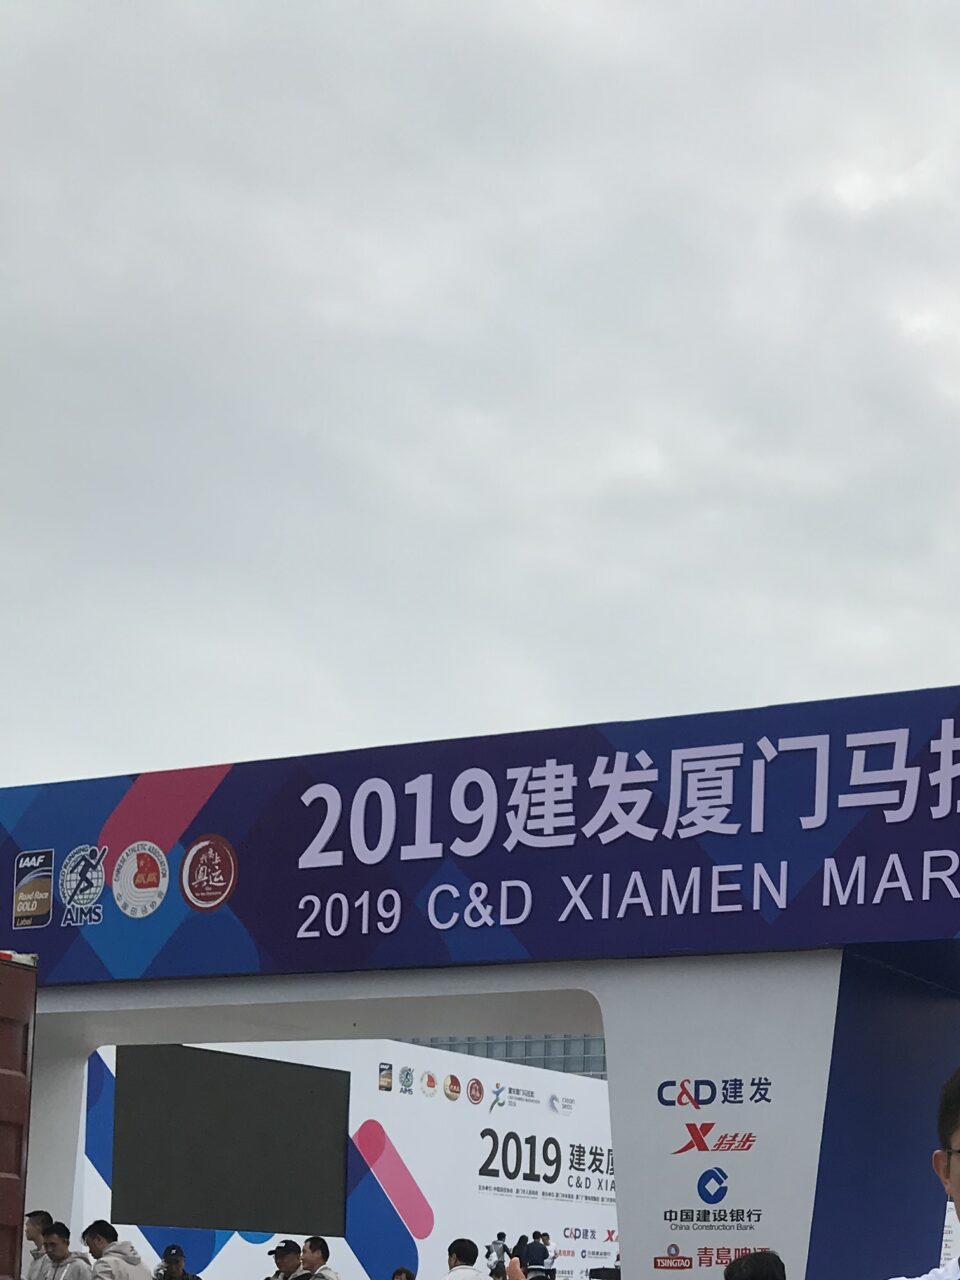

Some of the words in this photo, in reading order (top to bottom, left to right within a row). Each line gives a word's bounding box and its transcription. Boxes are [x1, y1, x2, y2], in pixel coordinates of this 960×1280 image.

[19, 855, 45, 868] IAAF
[17, 901, 37, 912] GOLD
[296, 887, 402, 939] 2019
[427, 878, 533, 930] C&D
[558, 861, 788, 922] XIAMEN
[61, 905, 103, 926] AIMS
[657, 1078, 717, 1110] C&D
[721, 1076, 772, 1105] 建发
[711, 1132, 757, 1151] 特步
[479, 1128, 561, 1184] 2019
[567, 1175, 591, 1189] C&D
[663, 1209, 762, 1222] 中国建设银行
[670, 1223, 690, 1231] China
[692, 1223, 735, 1231] Construction
[656, 1259, 691, 1267] TSINGTAO
[697, 1247, 771, 1267] 青島
